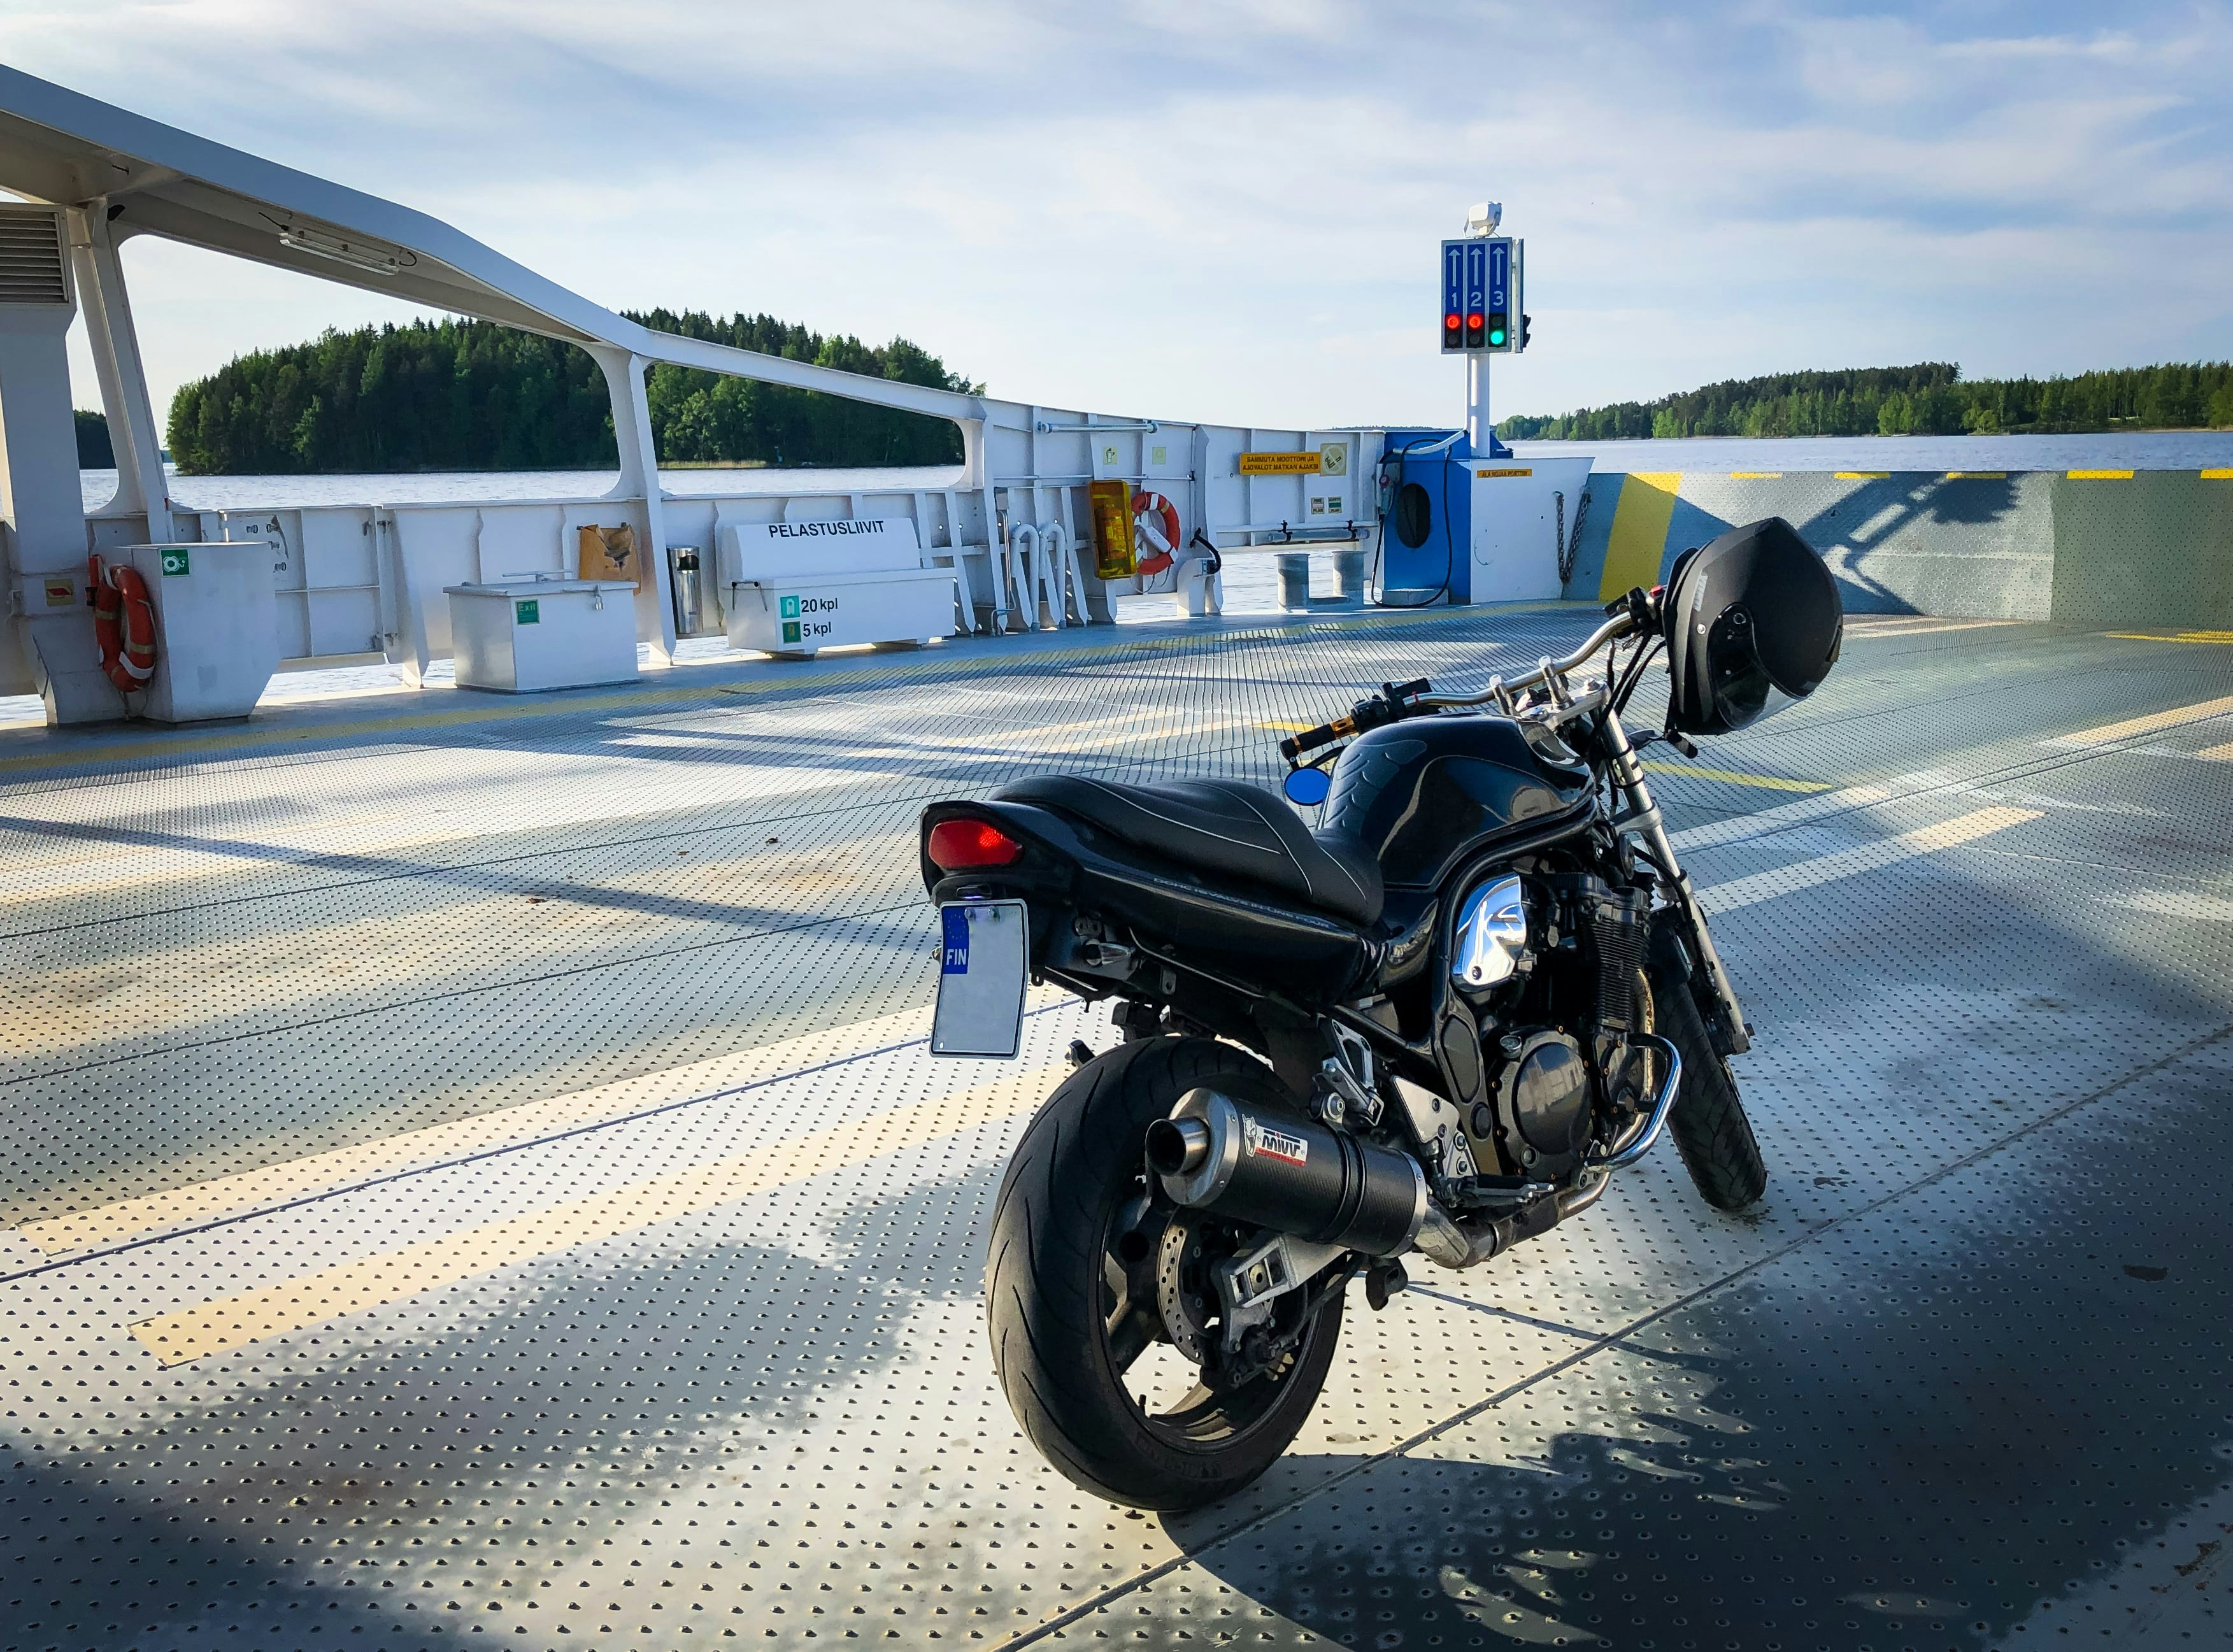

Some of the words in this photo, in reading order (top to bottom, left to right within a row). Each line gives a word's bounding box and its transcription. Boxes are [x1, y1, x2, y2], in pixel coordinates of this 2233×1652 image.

[1452, 292, 1457, 307] 1
[1471, 291, 1481, 307] 2
[1493, 290, 1504, 306] 3
[768, 520, 884, 538] PELASTUSLIIVIT
[801, 599, 818, 613] 20
[820, 597, 838, 613] kpl
[803, 623, 811, 637] 5
[813, 621, 832, 637] kpl
[946, 948, 967, 965] FIN
